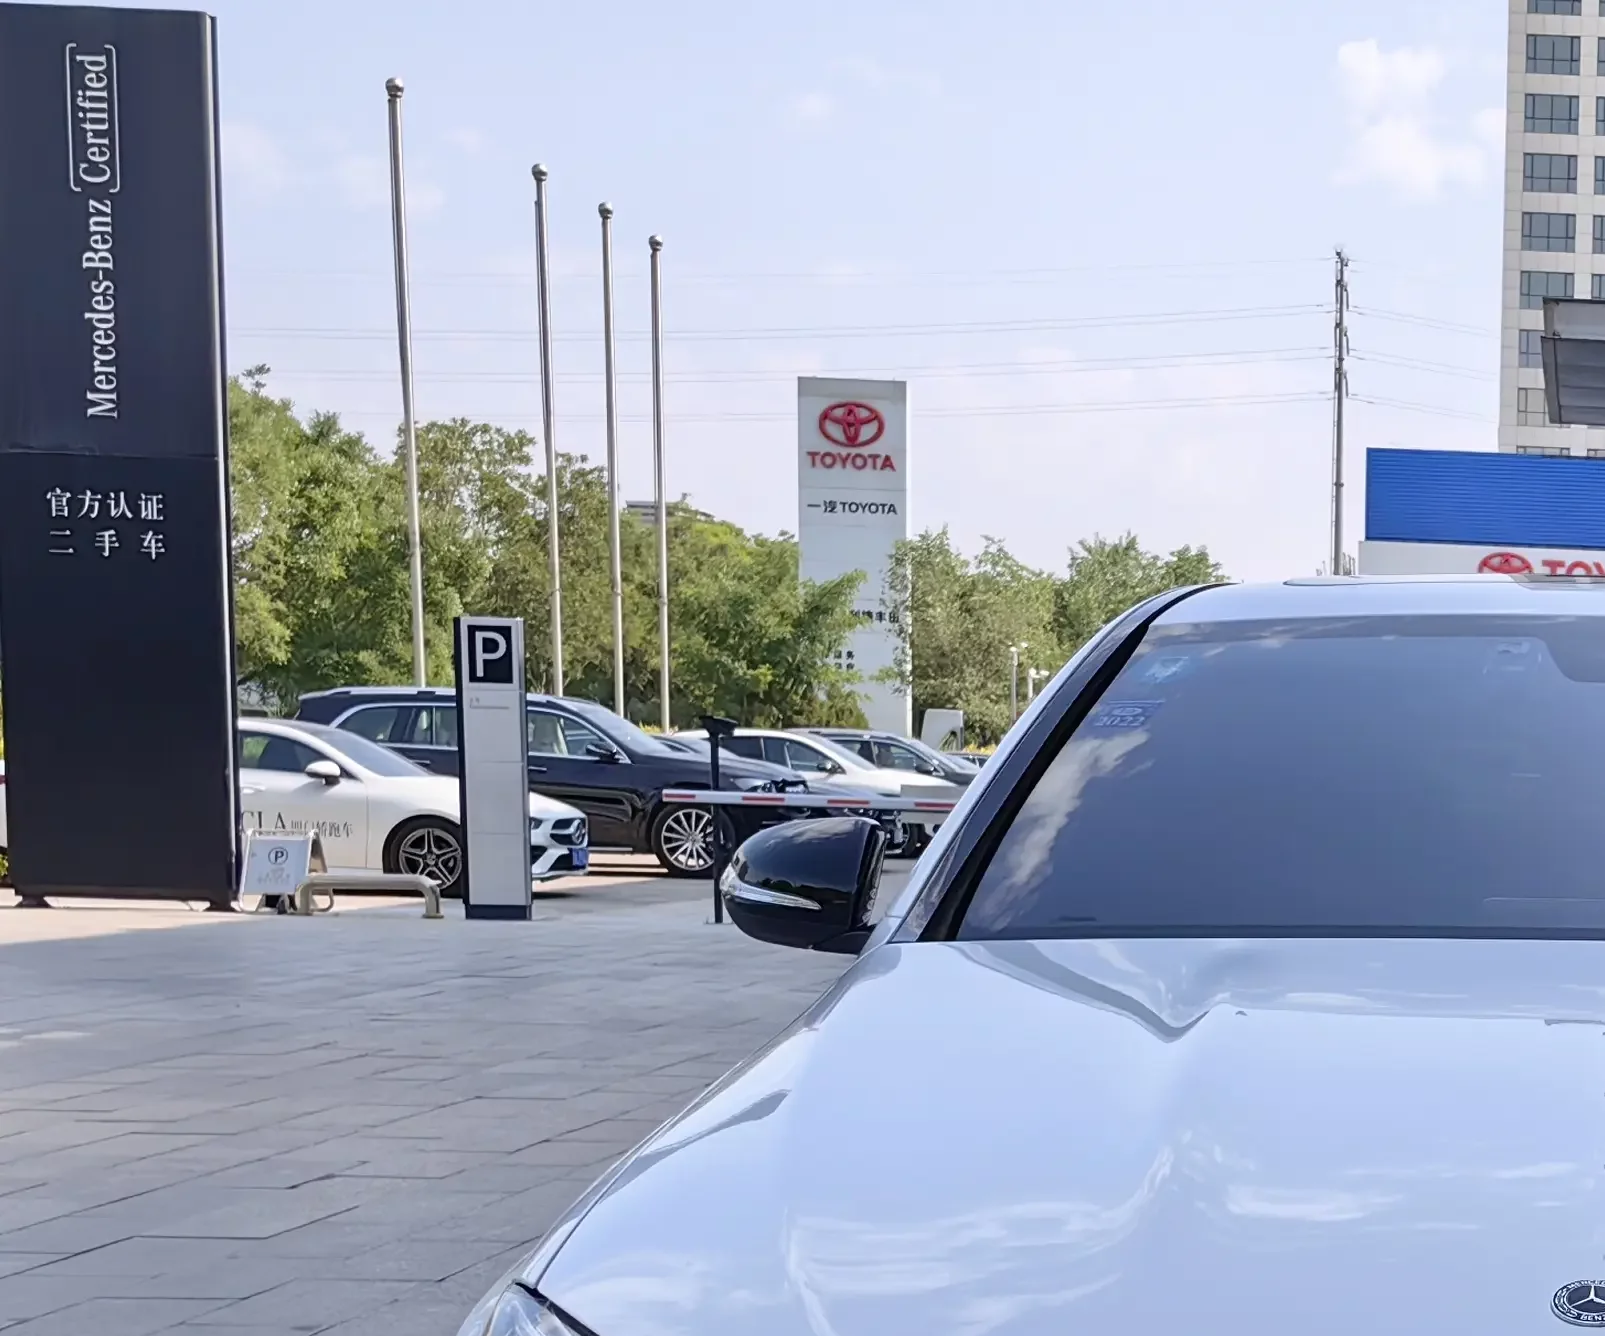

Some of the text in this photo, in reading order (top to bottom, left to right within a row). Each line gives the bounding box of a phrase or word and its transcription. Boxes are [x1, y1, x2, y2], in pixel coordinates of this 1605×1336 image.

[75, 53, 118, 420] Mercedes-Benz Certified
[806, 450, 897, 473] TOYOTA
[46, 487, 164, 521] 官方认证
[48, 529, 166, 560] 二手车
[475, 630, 507, 678] P
